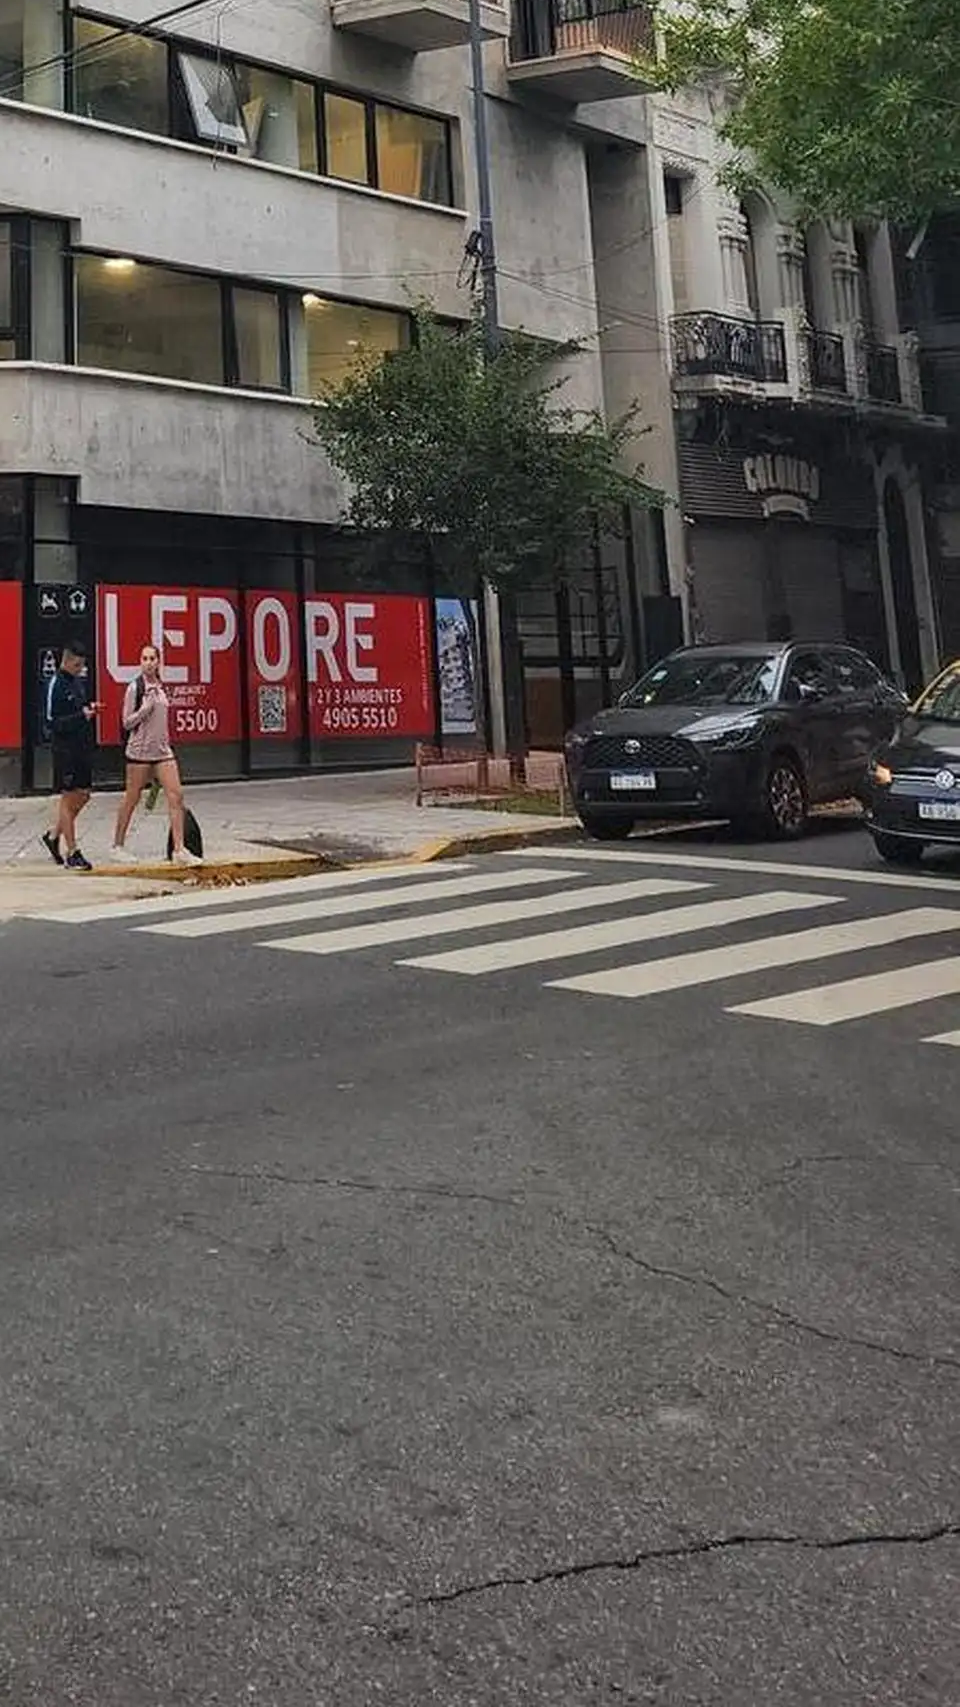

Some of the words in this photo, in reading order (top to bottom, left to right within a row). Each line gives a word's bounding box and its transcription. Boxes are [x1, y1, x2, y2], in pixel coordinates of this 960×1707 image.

[105, 593, 378, 682] LEPORE
[343, 688, 403, 704] AMBIENTES
[175, 709, 218, 731] 5500
[322, 707, 360, 728] 4905
[361, 706, 398, 728] 5510
